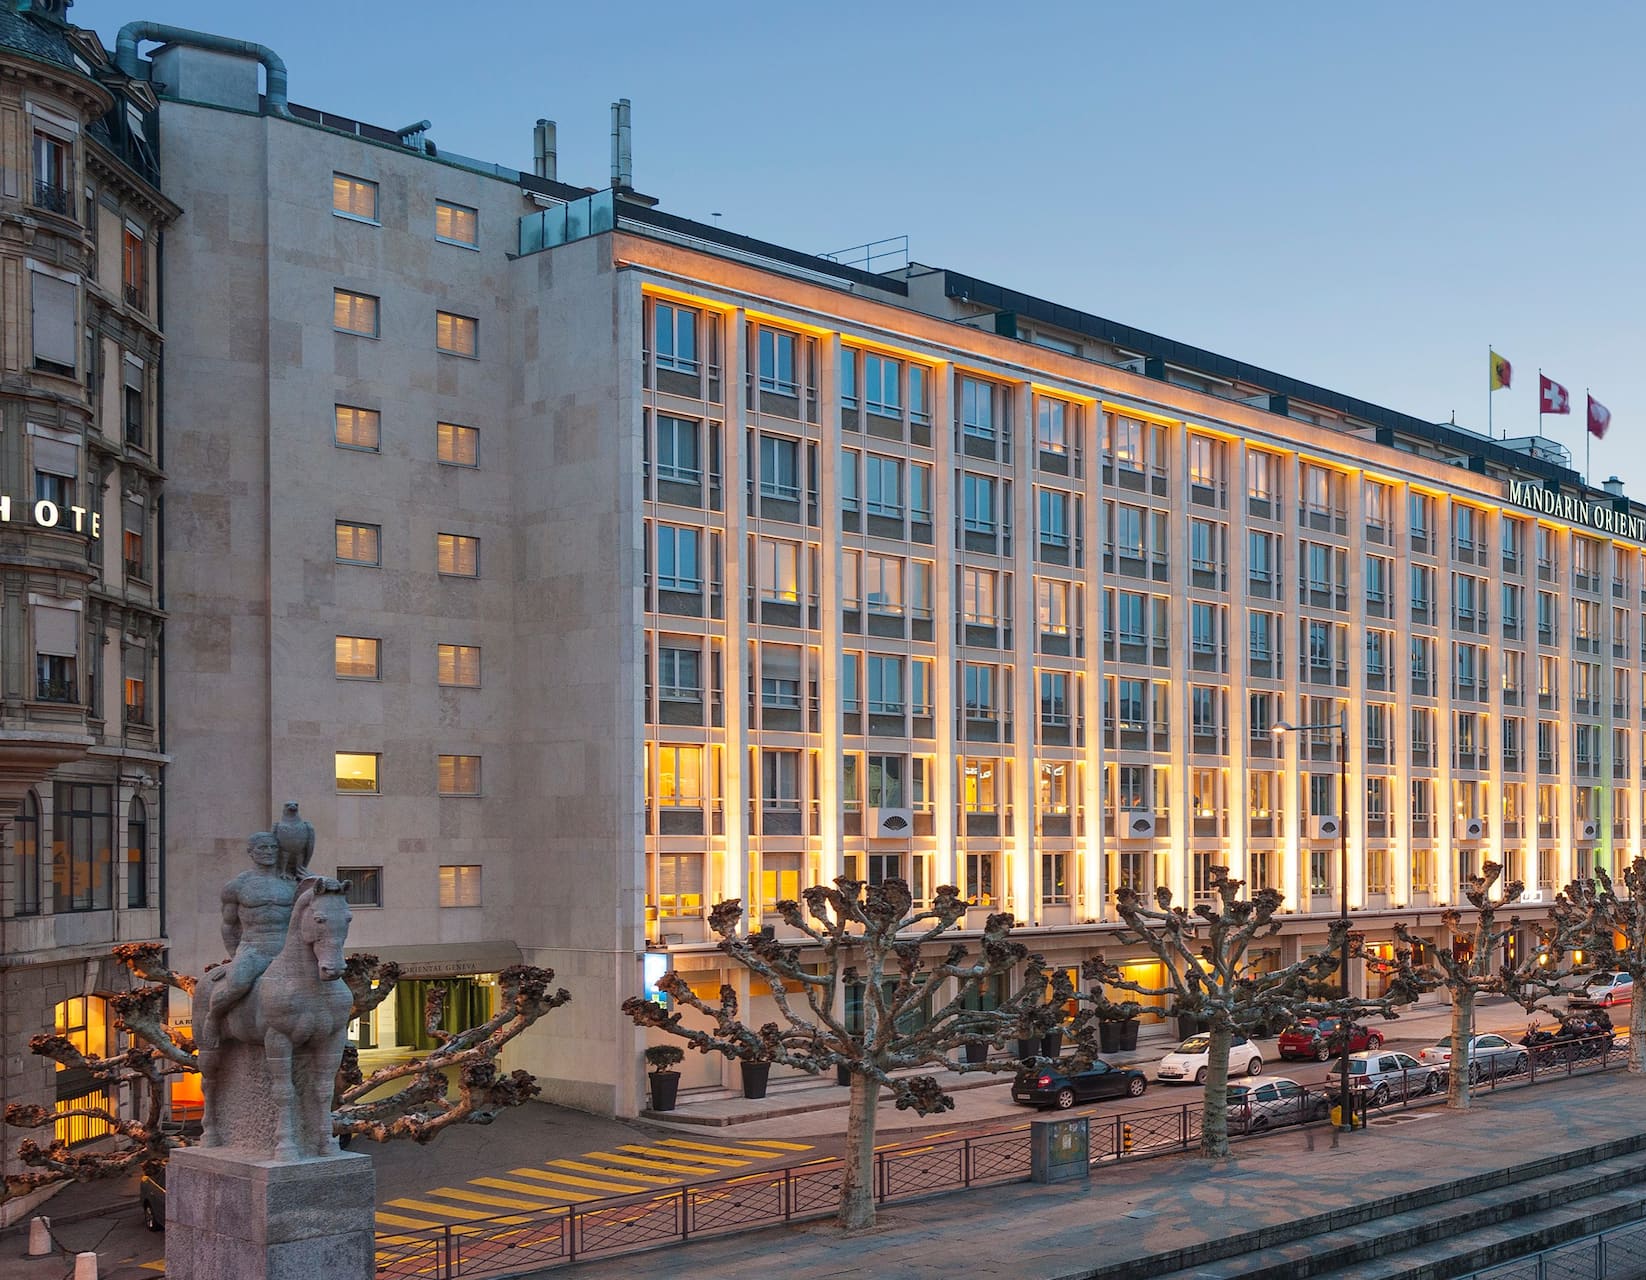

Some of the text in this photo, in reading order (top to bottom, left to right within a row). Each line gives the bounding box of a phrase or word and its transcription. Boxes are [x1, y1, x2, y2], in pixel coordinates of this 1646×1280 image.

[1508, 479, 1590, 525] MANDARIN
[403, 962, 478, 974] ORIENTAL GENEVA
